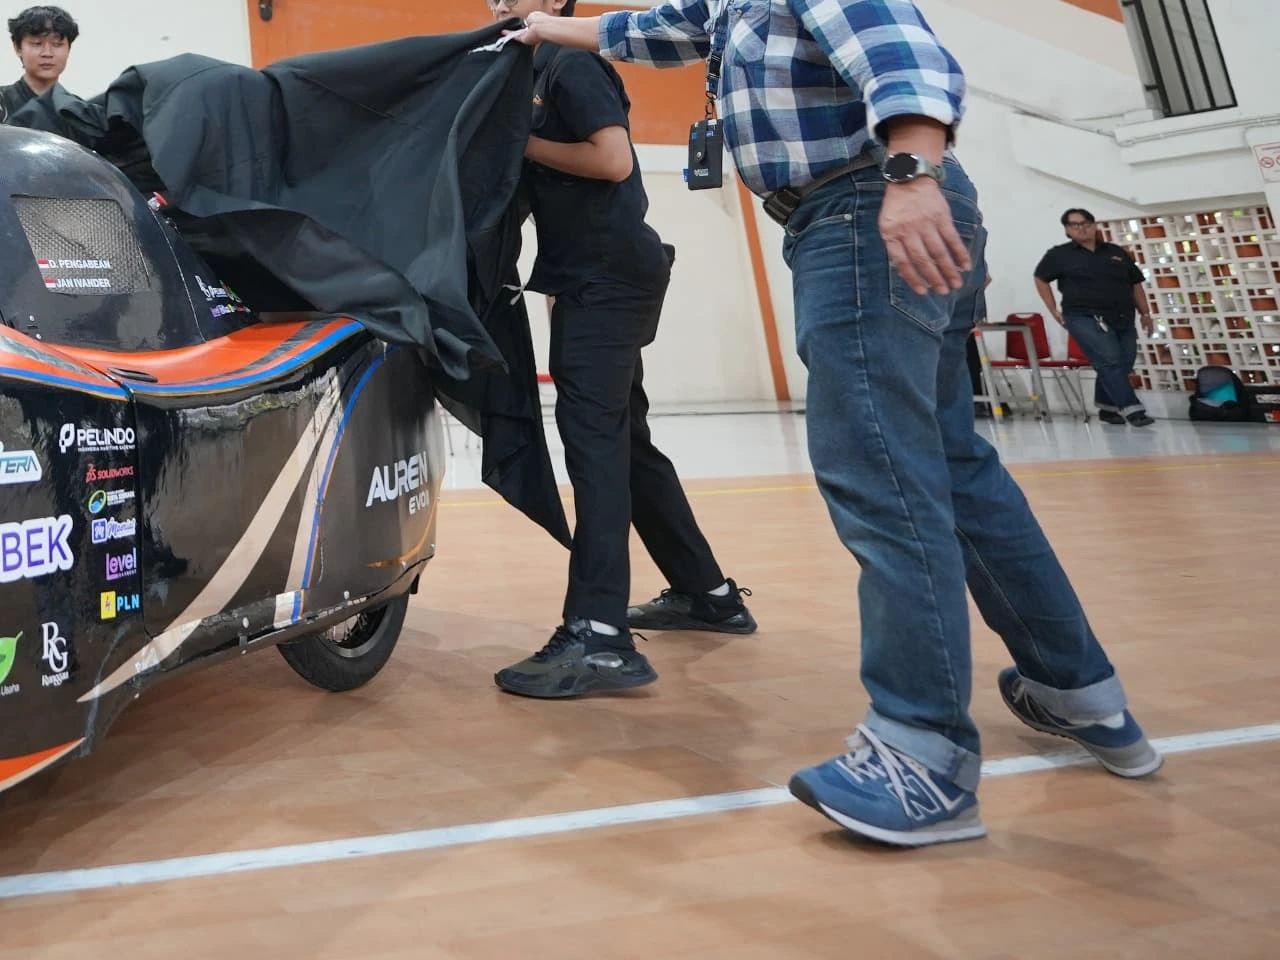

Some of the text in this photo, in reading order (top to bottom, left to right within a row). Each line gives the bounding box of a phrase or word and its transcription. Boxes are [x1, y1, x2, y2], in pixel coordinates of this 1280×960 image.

[76, 427, 135, 447] PELINDO
[365, 450, 429, 508] AUREN
[1, 523, 68, 572] BEK
[116, 593, 140, 612] PLN
